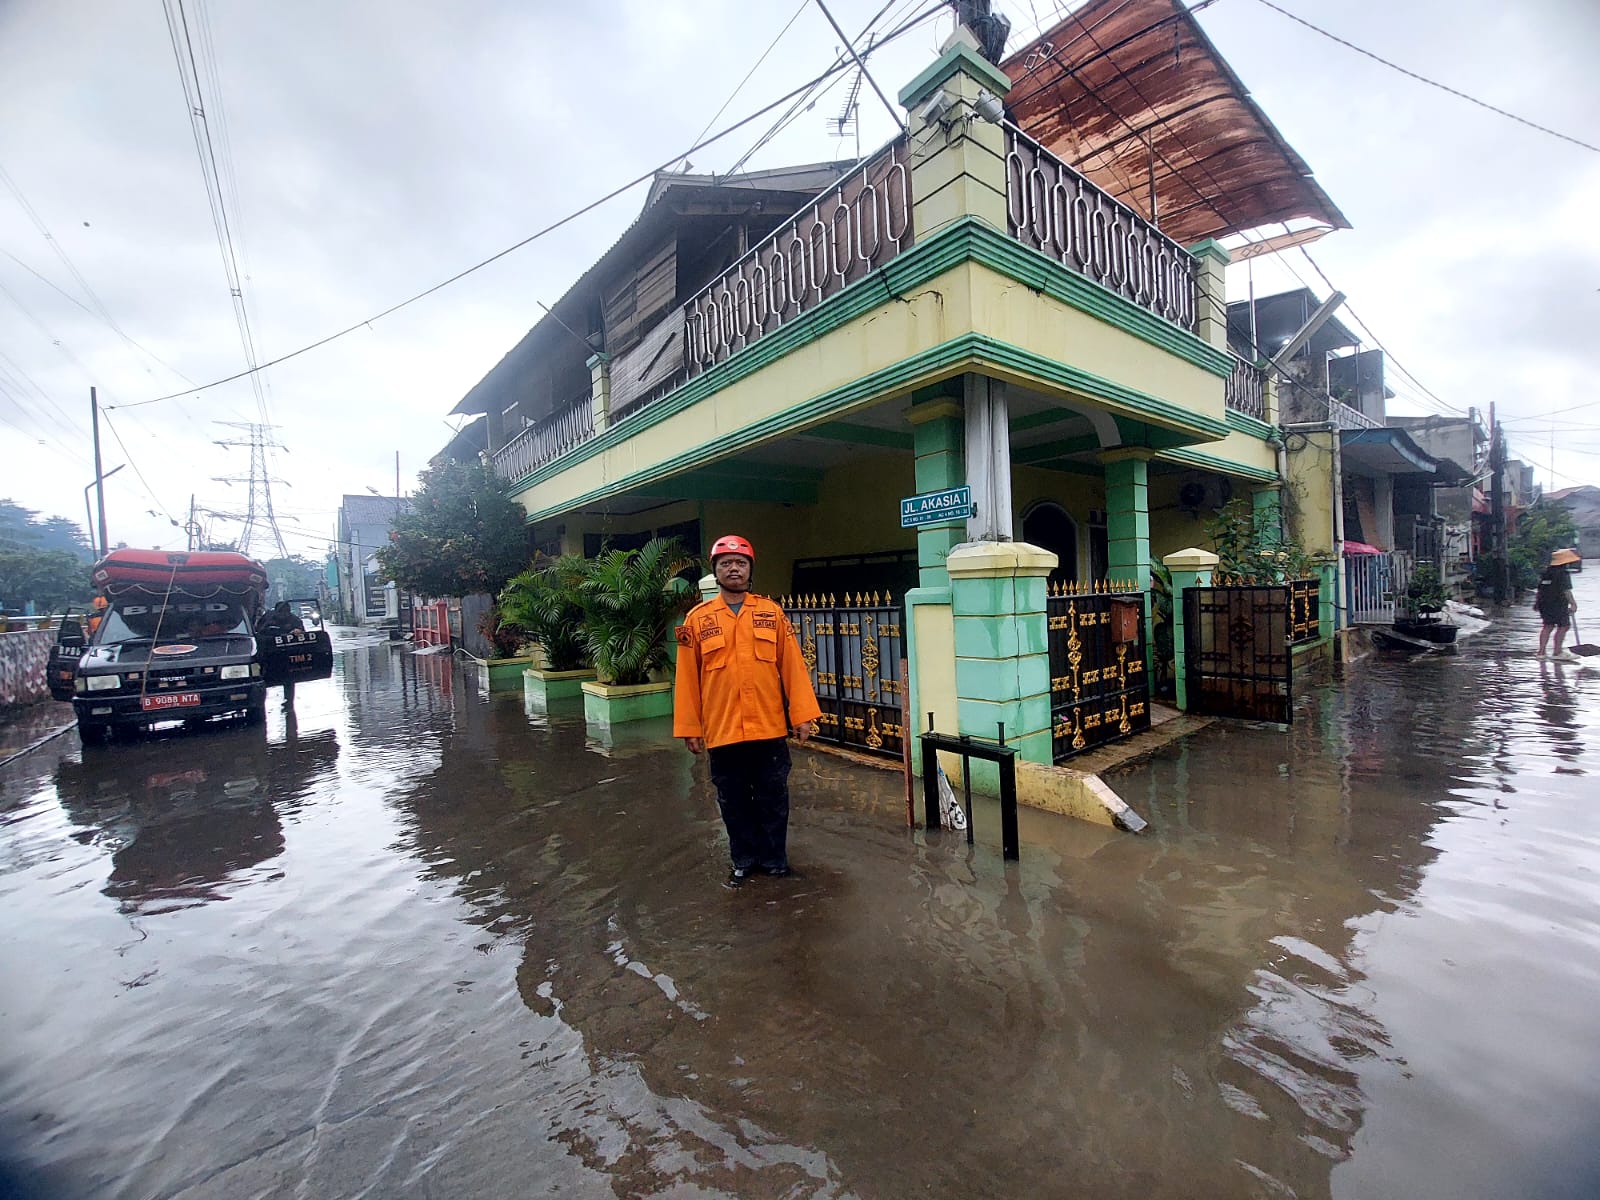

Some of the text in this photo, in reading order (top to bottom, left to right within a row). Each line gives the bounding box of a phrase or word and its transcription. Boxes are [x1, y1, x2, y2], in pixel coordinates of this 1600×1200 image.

[905, 491, 966, 513] JL. AKASIA I
[123, 602, 229, 616] BPBD
[275, 632, 317, 644] BPBD
[289, 653, 312, 663] TIM 2
[145, 698, 151, 706] B
[182, 694, 199, 703] NTA
